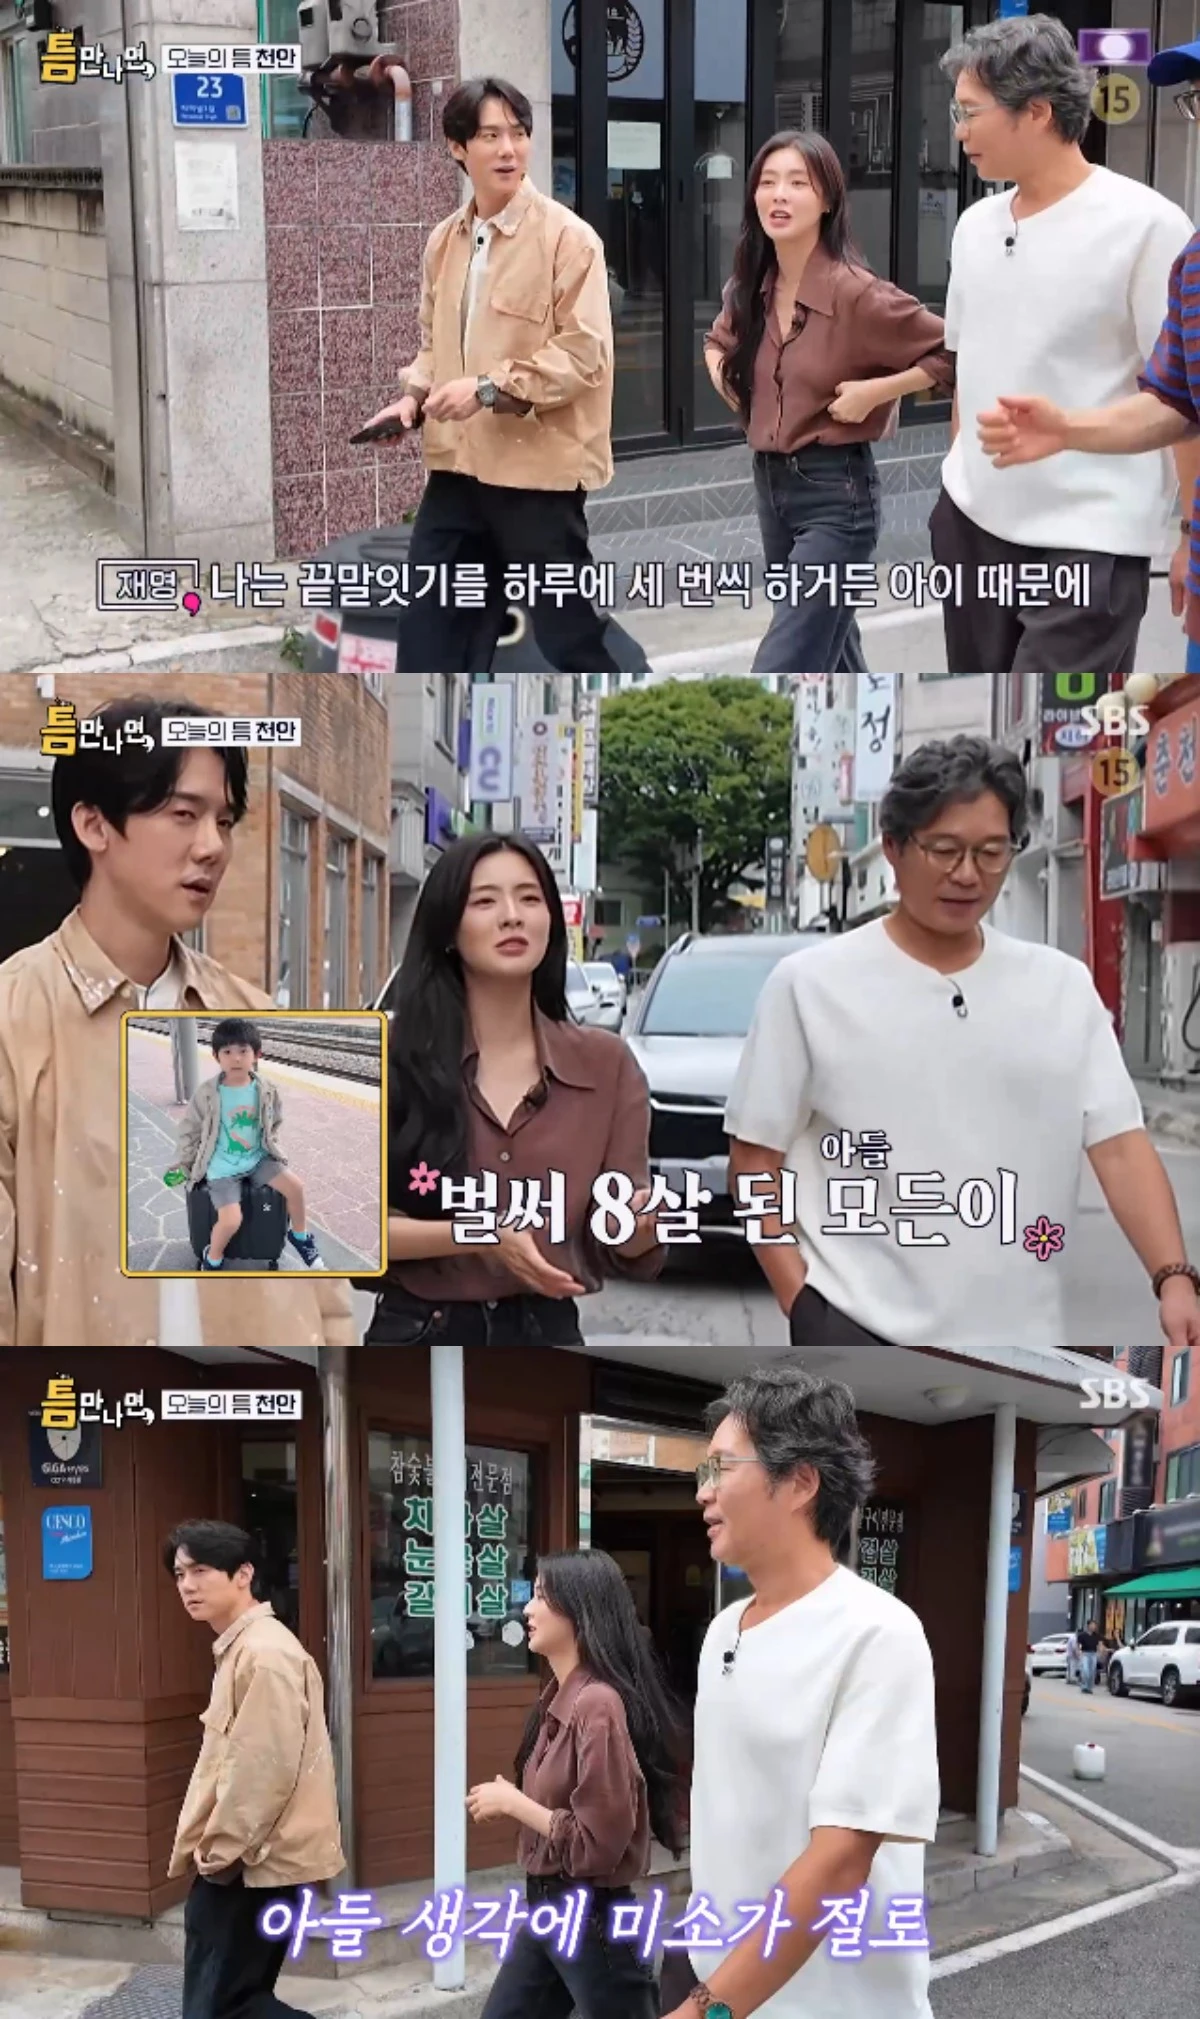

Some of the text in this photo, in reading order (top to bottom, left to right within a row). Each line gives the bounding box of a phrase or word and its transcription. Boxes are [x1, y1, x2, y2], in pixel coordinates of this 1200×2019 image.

[197, 76, 223, 98] 23
[477, 745, 502, 793] CU
[390, 1450, 514, 1495] 참숯불전문점
[859, 1537, 899, 1566] 겹살
[404, 1581, 508, 1618] 갈살
